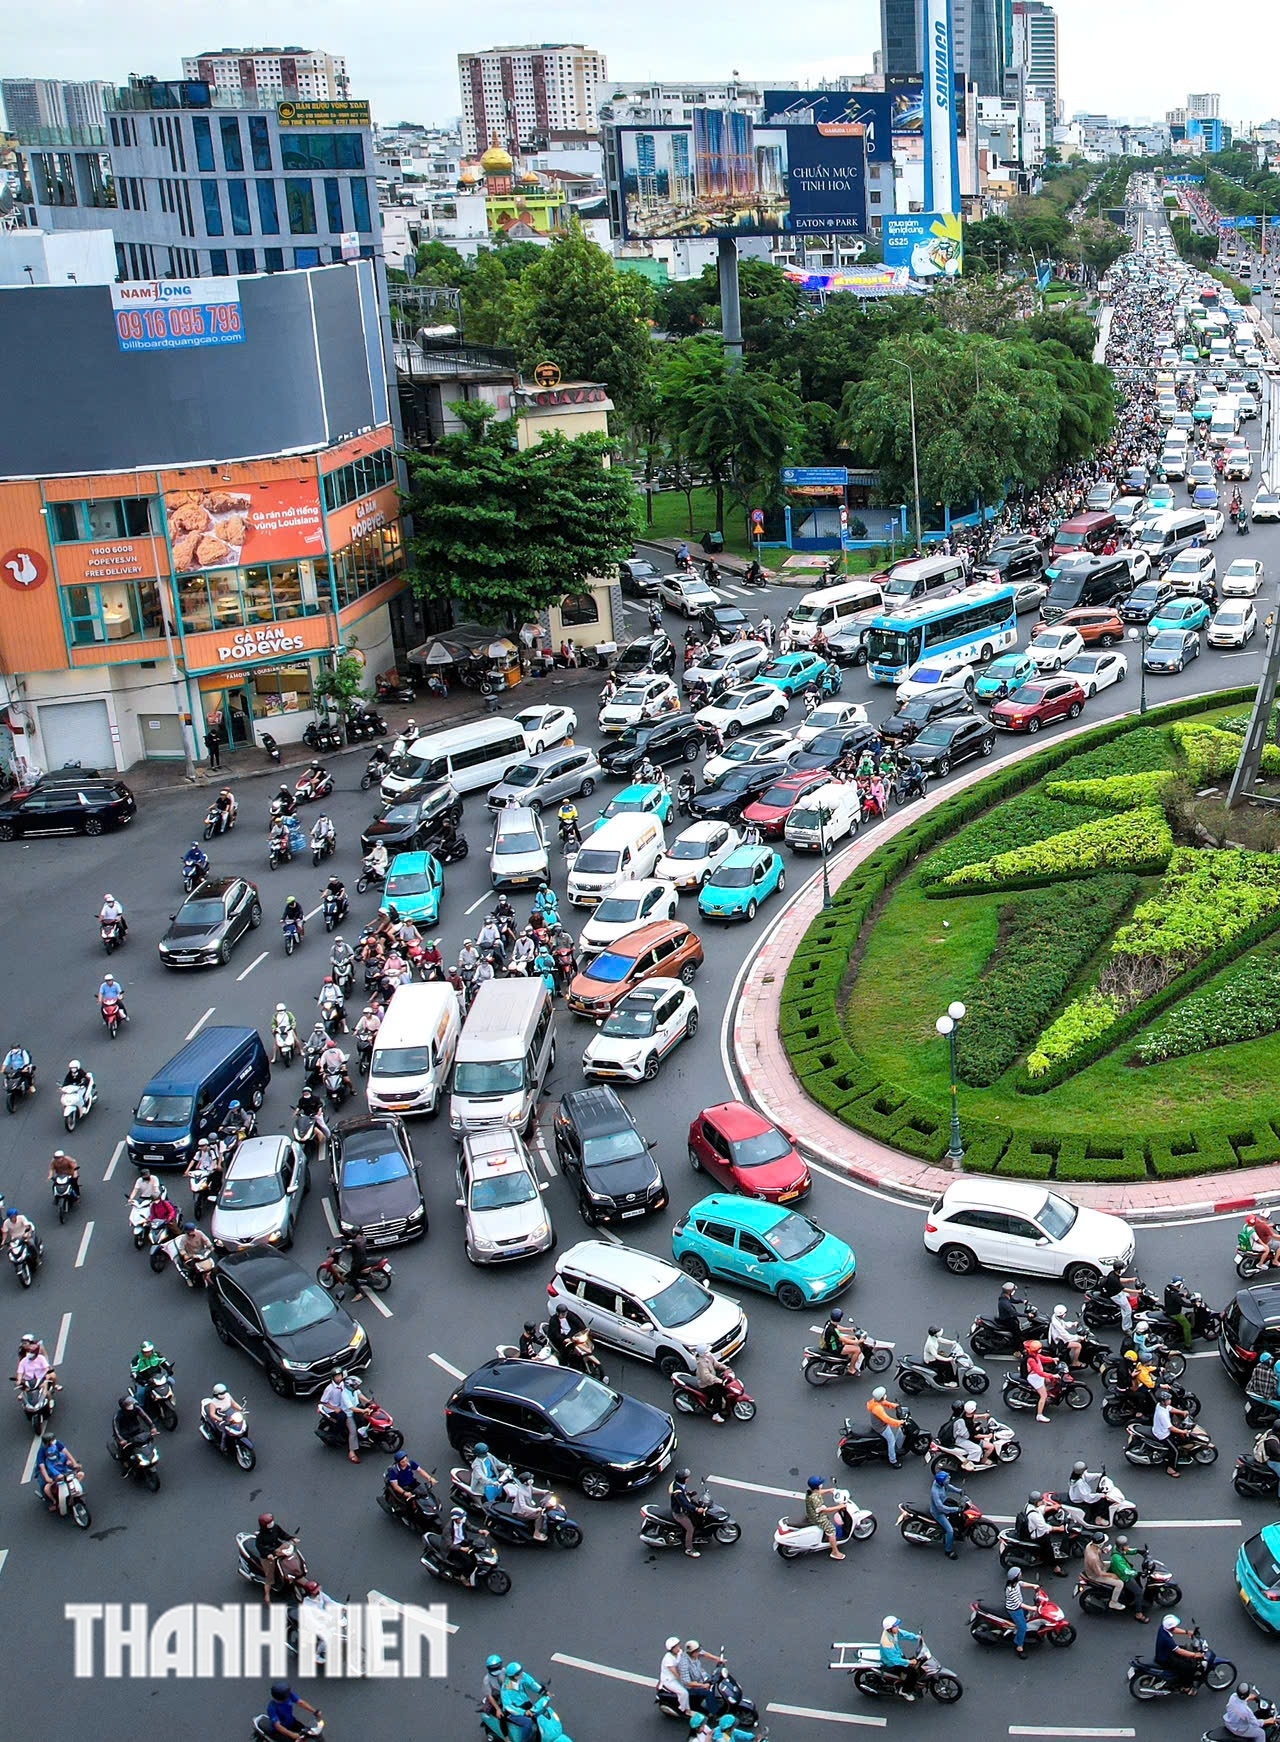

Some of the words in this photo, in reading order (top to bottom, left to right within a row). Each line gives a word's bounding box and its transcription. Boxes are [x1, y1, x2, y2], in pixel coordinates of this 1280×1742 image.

[934, 20, 948, 111] SAWACO
[800, 180, 825, 191] TINH
[828, 180, 851, 191] HOA
[796, 219, 825, 228] EATON
[836, 218, 858, 227] PARK
[888, 237, 909, 246] GS25
[120, 288, 151, 299] NAM
[117, 309, 167, 340] 0916
[169, 307, 204, 336] 095
[206, 303, 240, 334] 795
[122, 334, 242, 349] billboardquangcao.com
[252, 512, 265, 521] Gà
[265, 510, 281, 519] rán
[295, 505, 319, 517] tiếng
[254, 520, 277, 530] vùng
[277, 517, 320, 528] Louisiana
[91, 547, 111, 556] 1900
[88, 555, 137, 567] POPEYES.VN
[84, 569, 105, 577] FREE
[105, 566, 143, 576] DELIVERY
[234, 629, 254, 645] GÀ
[255, 625, 285, 642] RÁN
[226, 670, 251, 680] FAMOUS
[287, 660, 312, 670] CHICKEN
